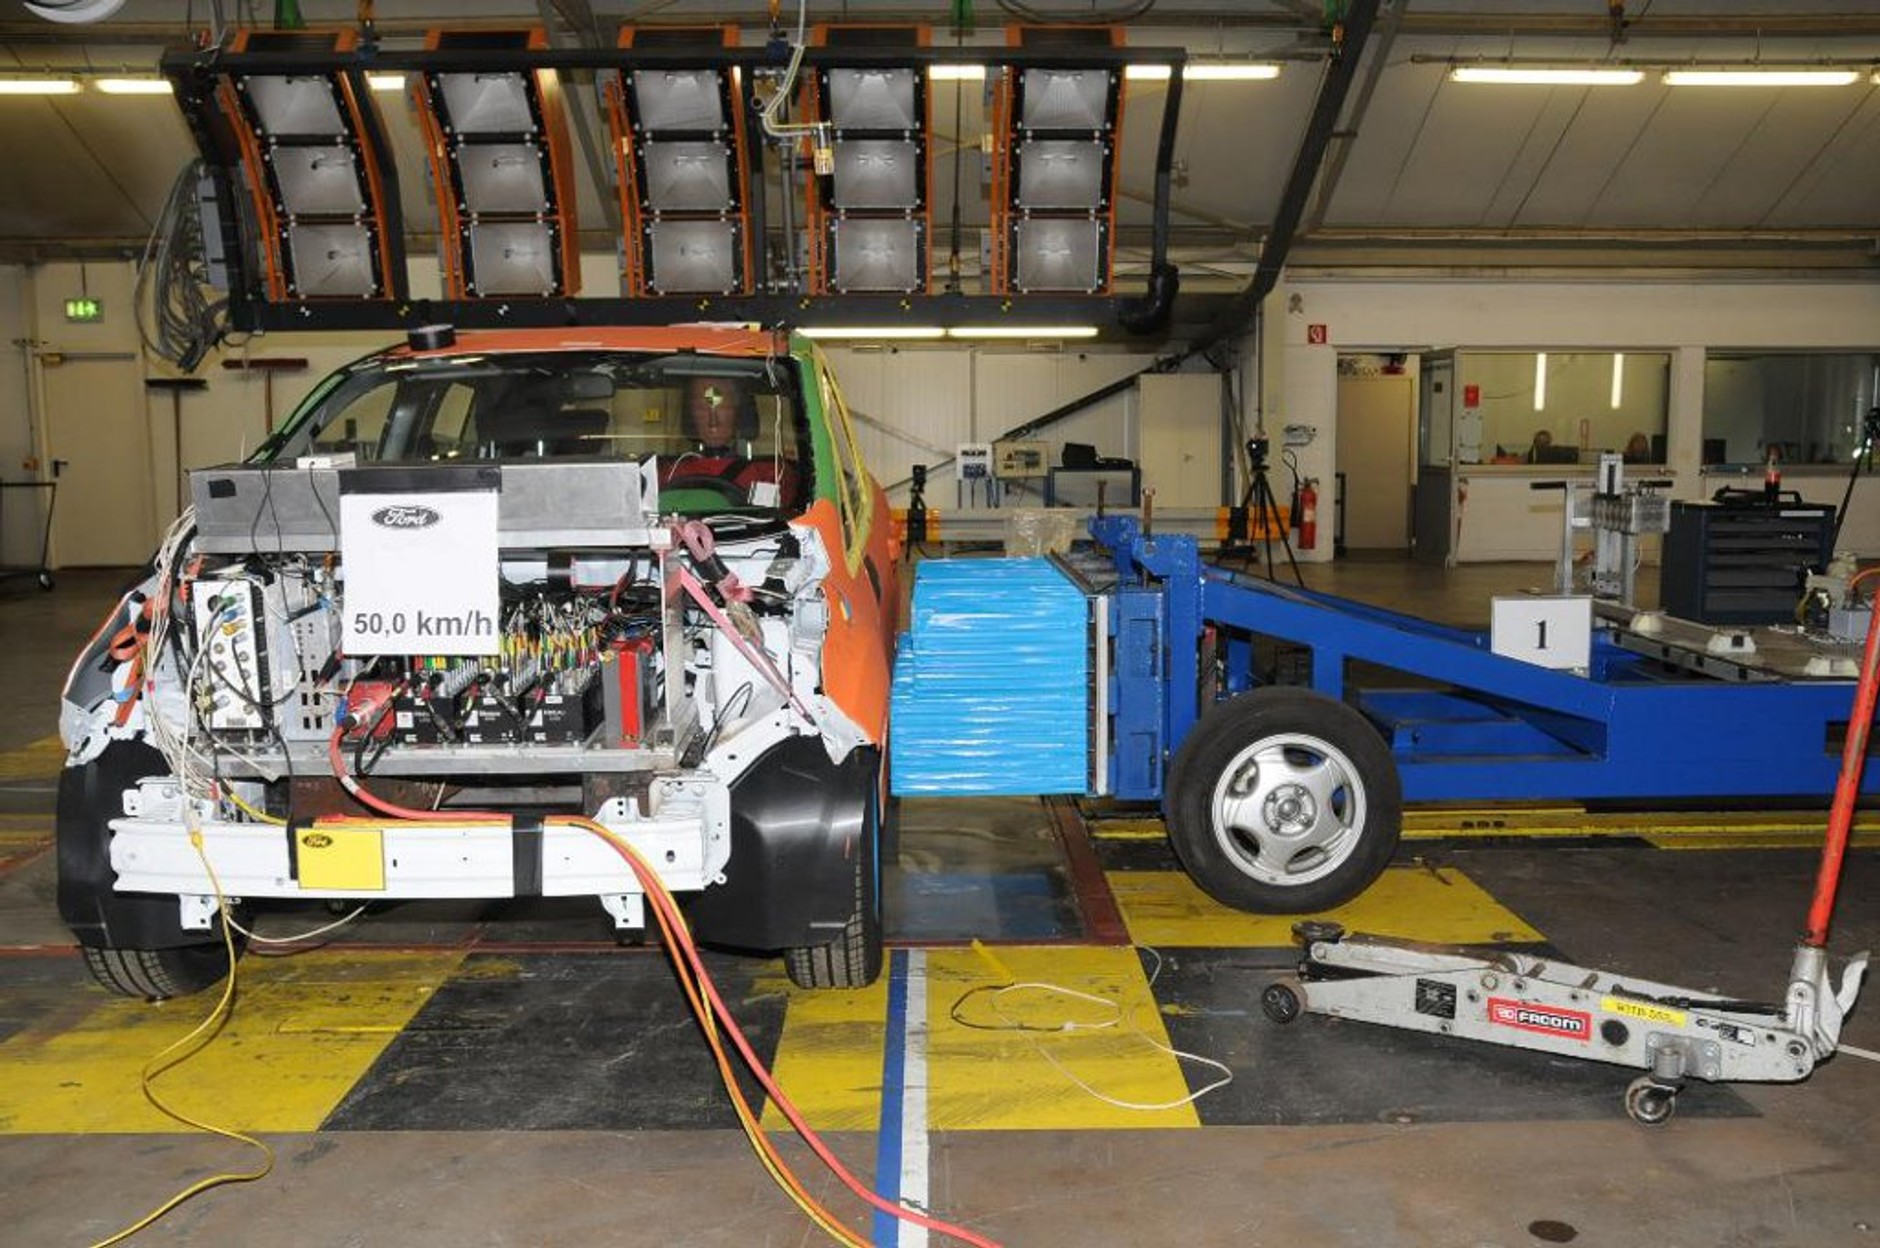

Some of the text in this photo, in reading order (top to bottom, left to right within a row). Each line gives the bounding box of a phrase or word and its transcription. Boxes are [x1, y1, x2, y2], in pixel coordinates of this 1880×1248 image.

[383, 506, 428, 526] Ford
[354, 610, 492, 638] 50,0 km/h
[1536, 619, 1549, 650] 1
